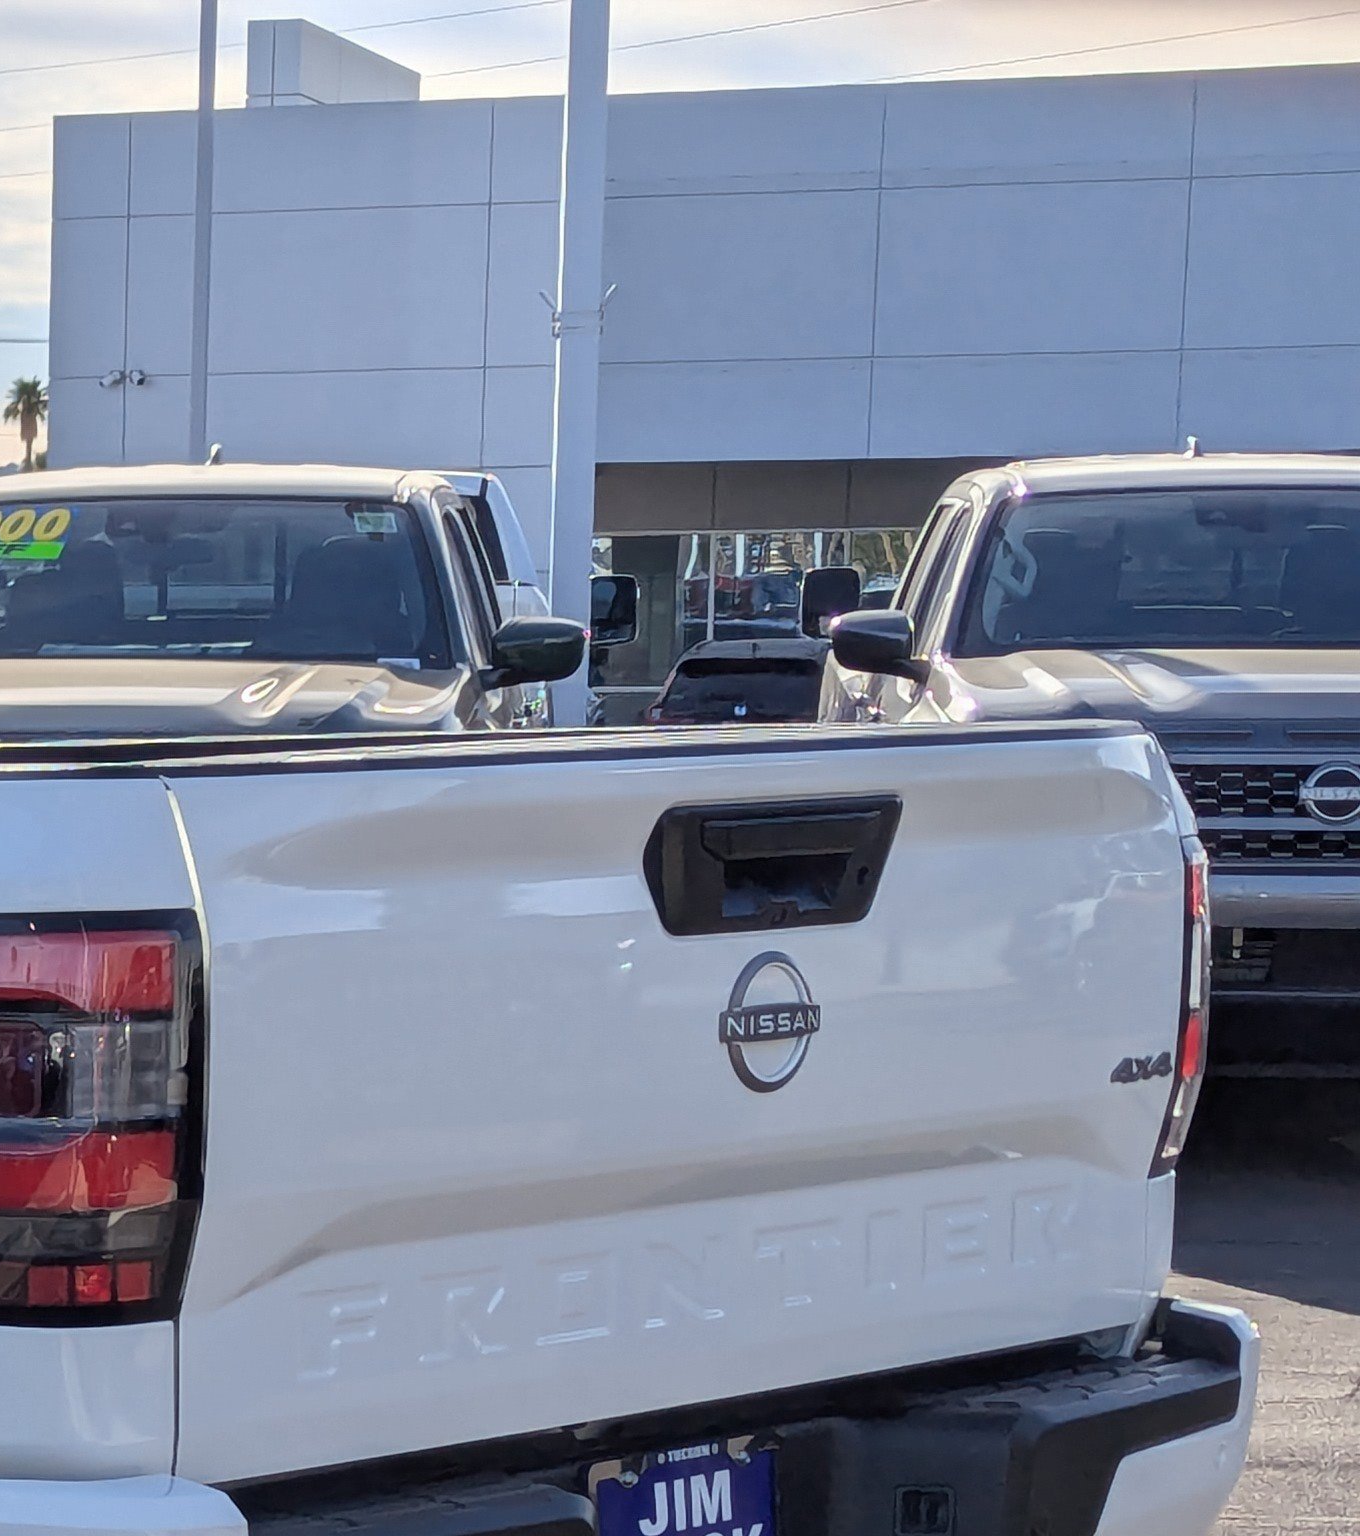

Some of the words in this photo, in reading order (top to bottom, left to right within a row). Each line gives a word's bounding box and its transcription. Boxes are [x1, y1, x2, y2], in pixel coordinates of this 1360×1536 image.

[726, 1008, 820, 1037] NISSAN
[297, 1183, 1079, 1382] FRONTIER
[638, 1469, 733, 1536] JIM
